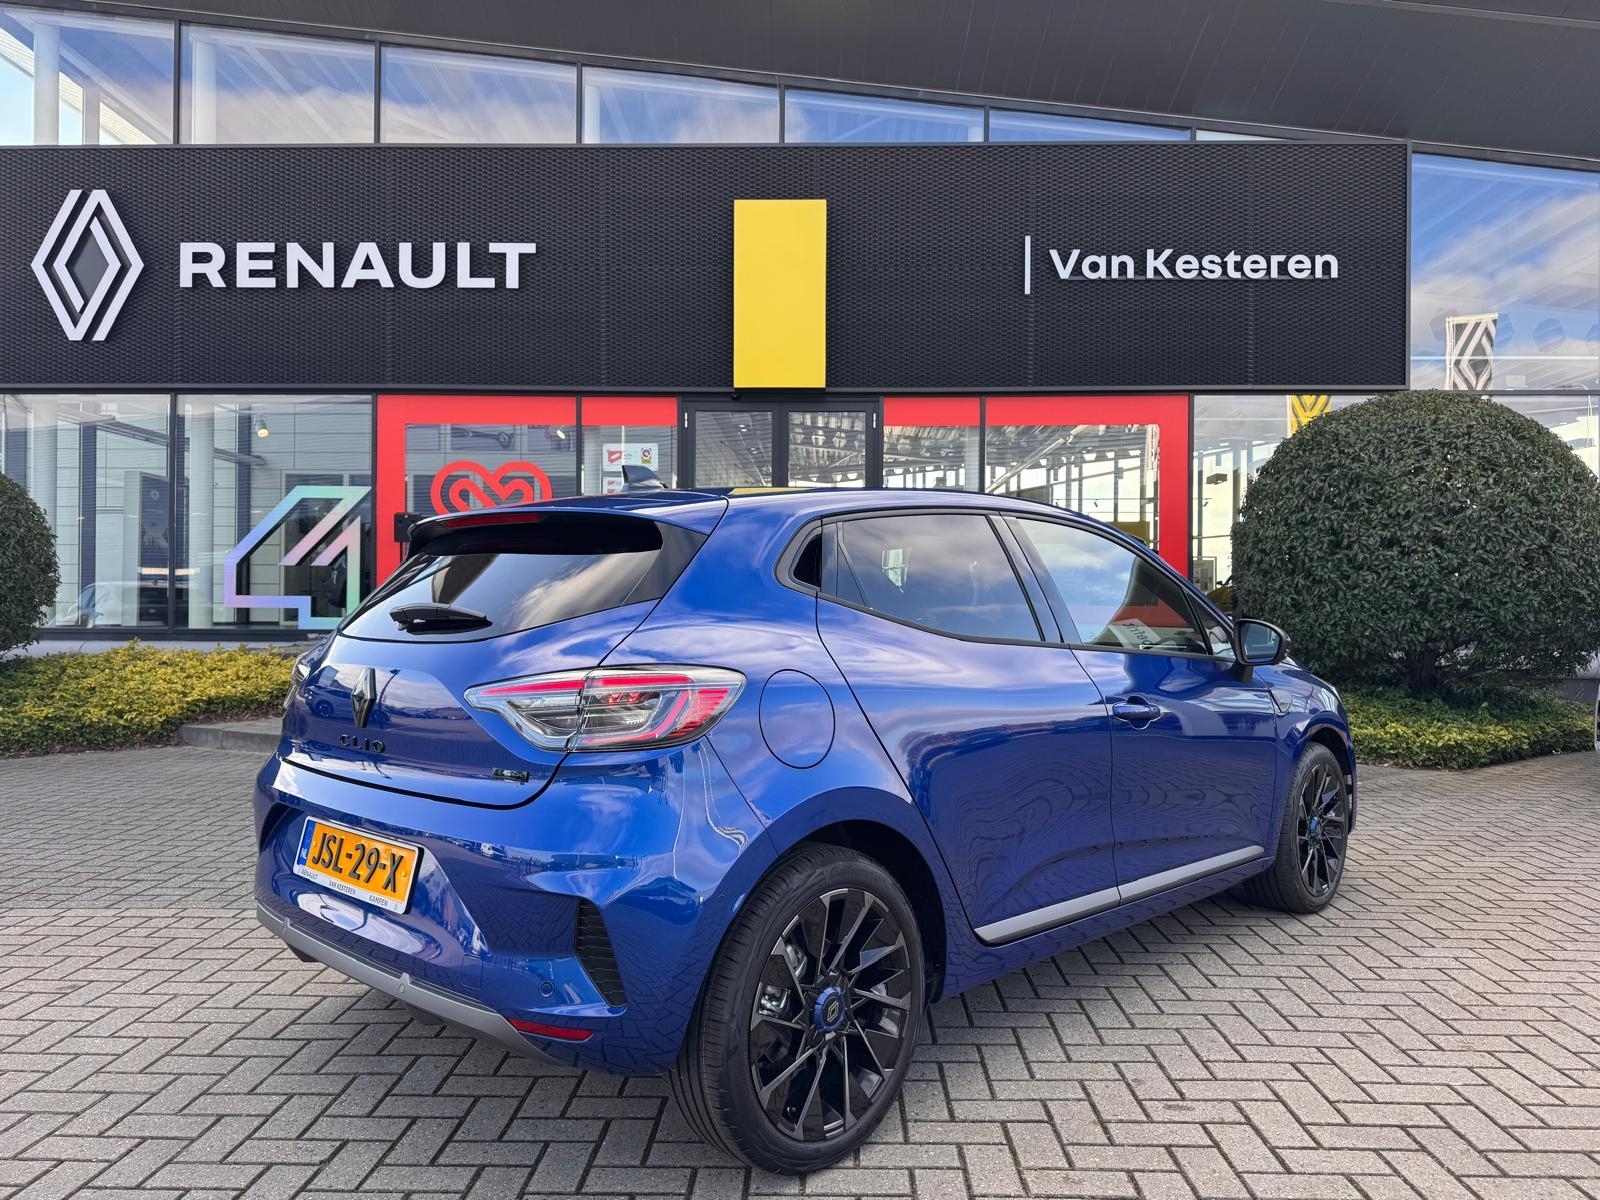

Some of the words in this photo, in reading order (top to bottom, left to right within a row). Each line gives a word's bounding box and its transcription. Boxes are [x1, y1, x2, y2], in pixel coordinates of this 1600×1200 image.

[180, 242, 536, 289] RENAULT
[1049, 249, 1135, 279] Van
[1146, 248, 1339, 279] Kesteren
[340, 734, 386, 753] CLIO
[300, 847, 308, 860] NL
[312, 833, 403, 893] JSL-29-X
[336, 882, 357, 896] KESTEREN
[368, 894, 389, 907] KAMPEN
